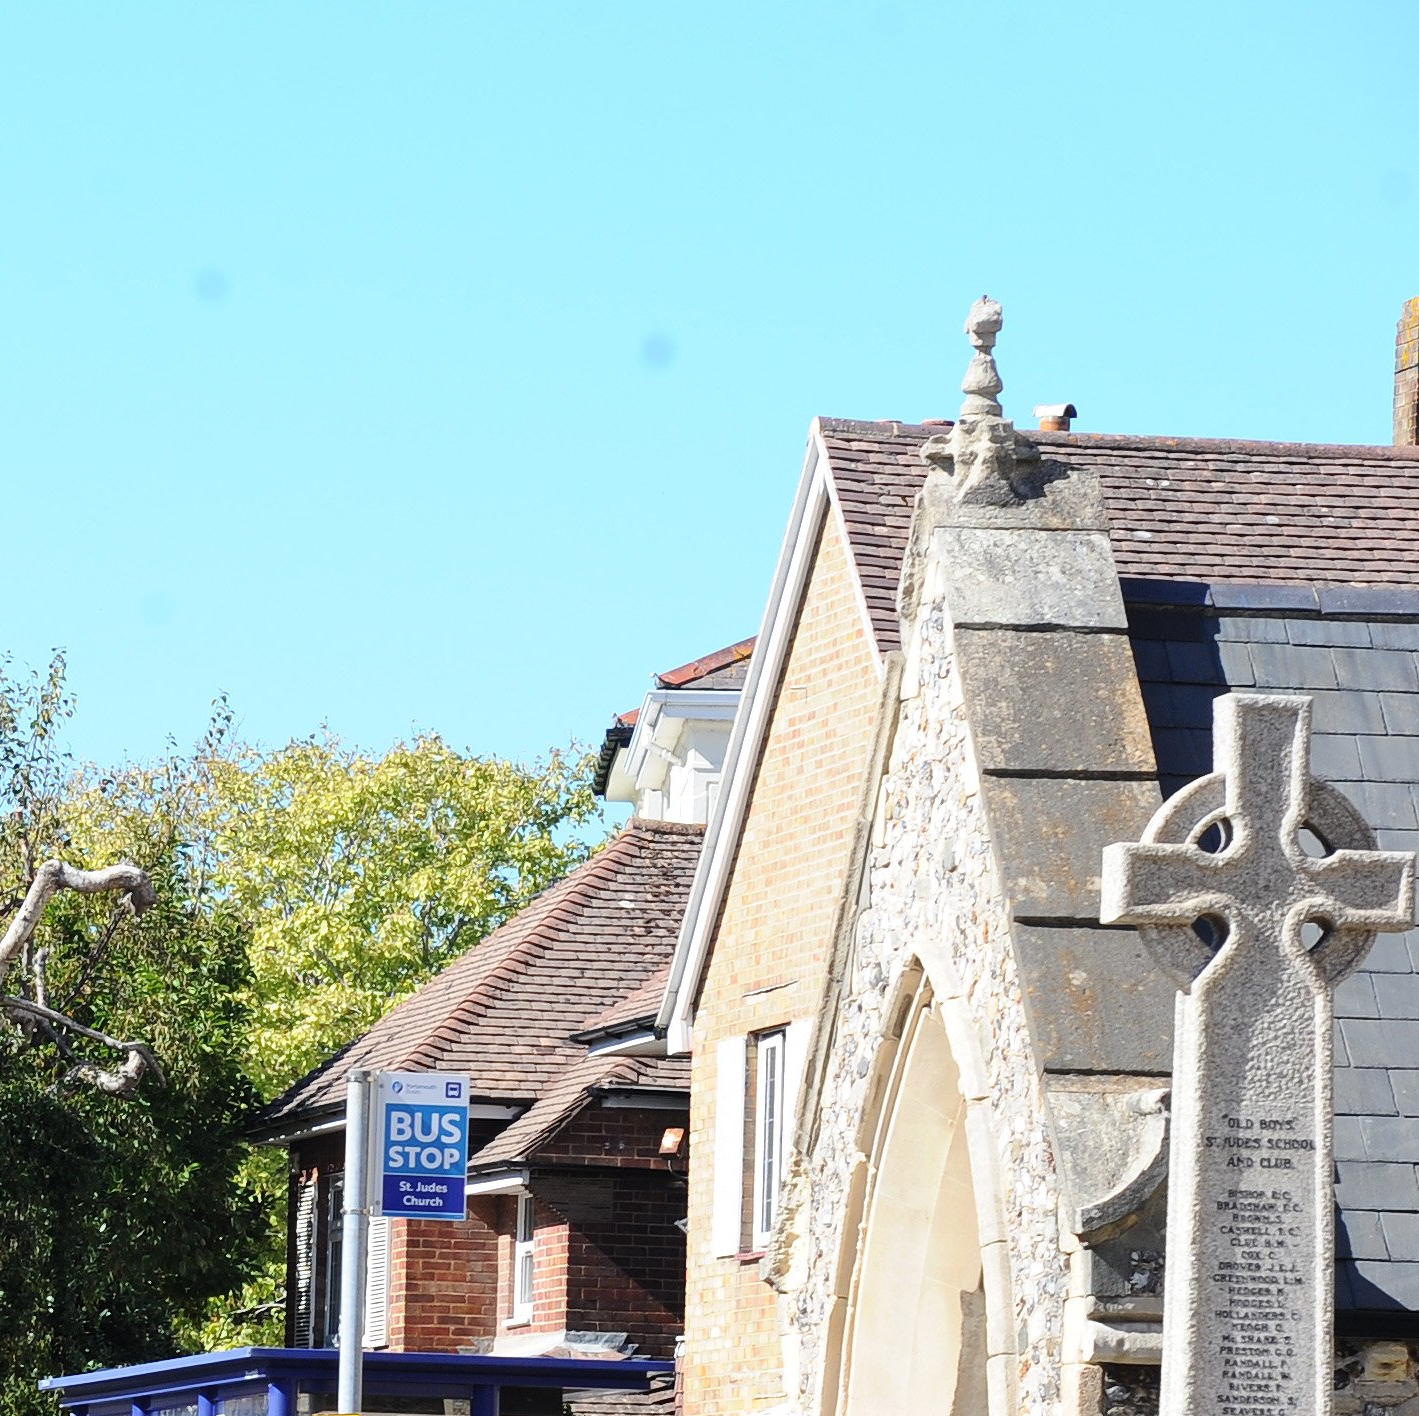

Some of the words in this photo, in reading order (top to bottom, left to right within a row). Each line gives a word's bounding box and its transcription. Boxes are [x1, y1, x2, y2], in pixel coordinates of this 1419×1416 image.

[390, 1111, 462, 1144] BUS
[1267, 1138, 1316, 1150] SCHOOL
[388, 1146, 460, 1170] STOP
[1227, 1157, 1254, 1168] AND
[416, 1182, 448, 1193] Judes
[403, 1195, 443, 1207] Church
